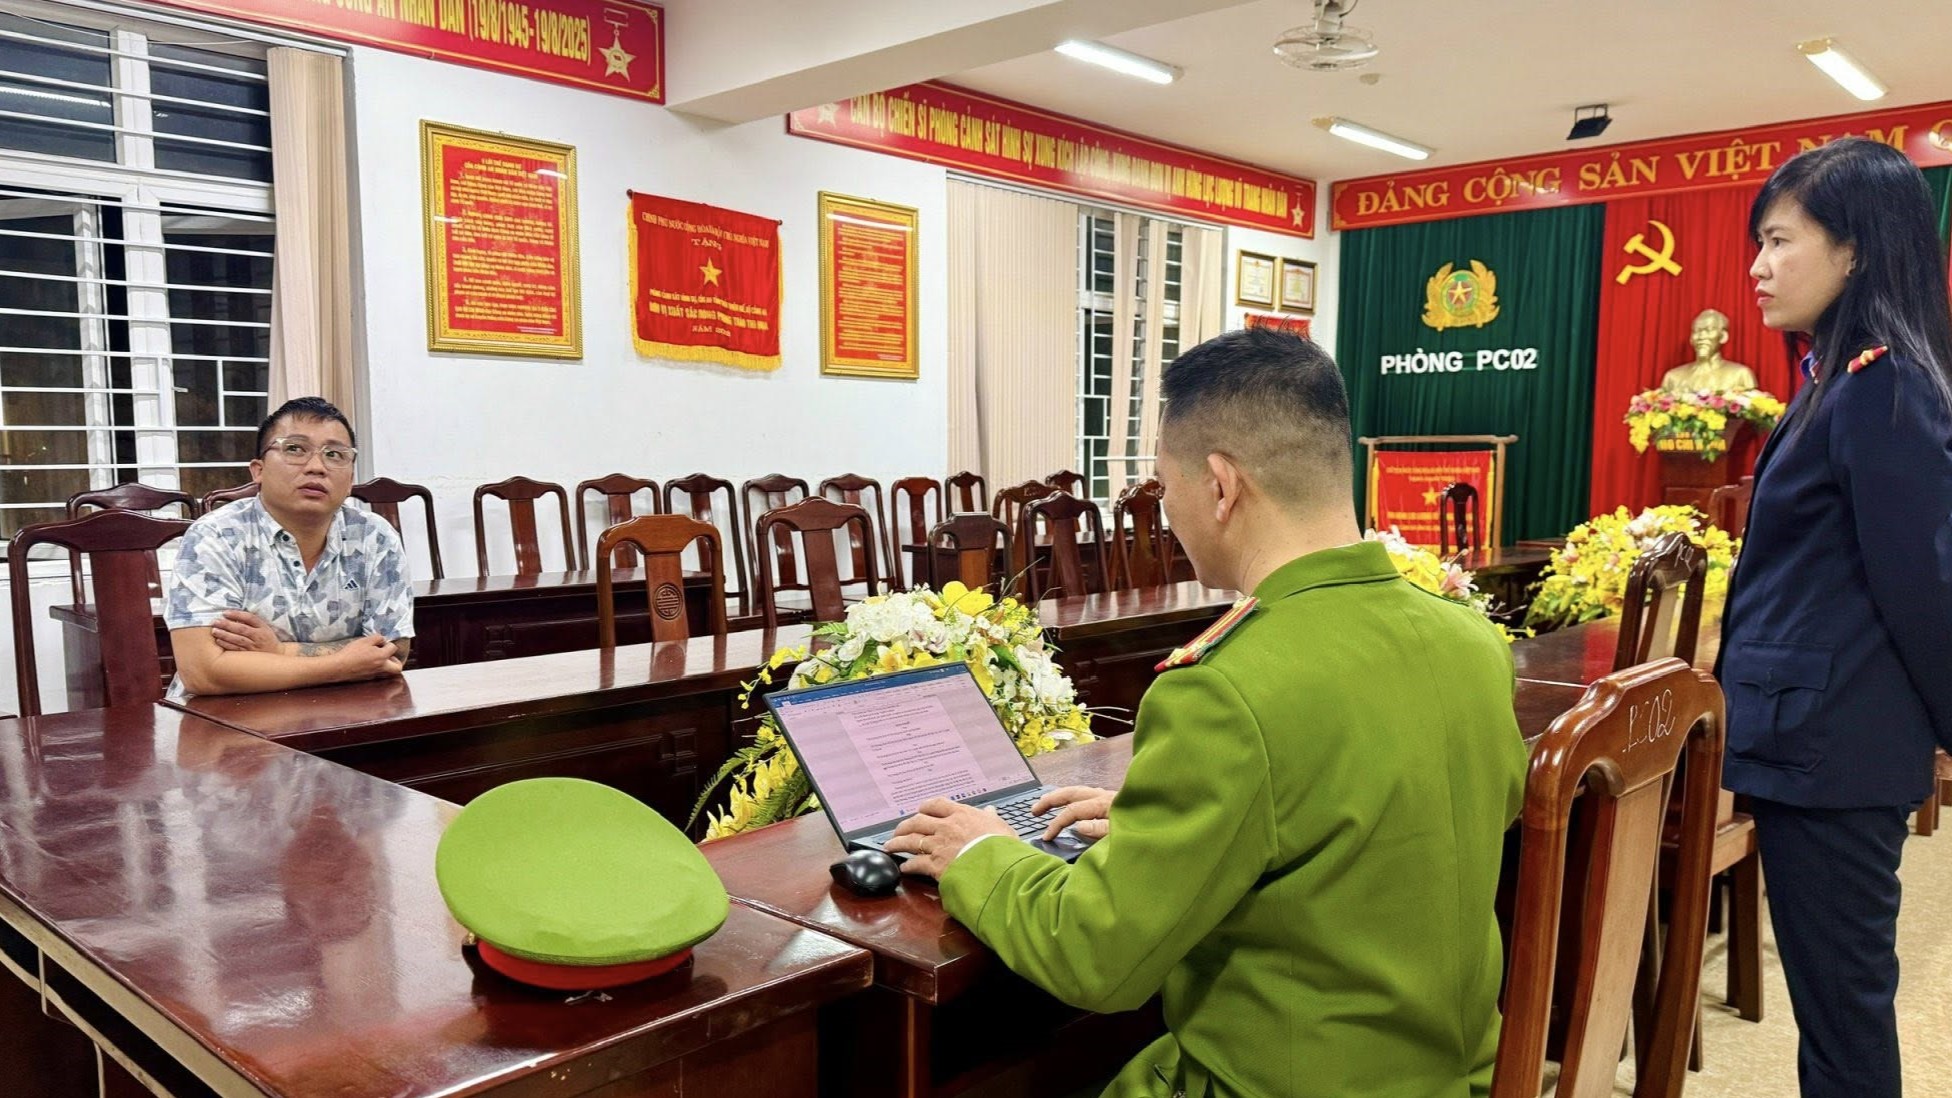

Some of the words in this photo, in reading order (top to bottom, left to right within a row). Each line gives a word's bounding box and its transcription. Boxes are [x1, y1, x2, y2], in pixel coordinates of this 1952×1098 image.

[1356, 179, 1450, 216] ĐẢNG
[1463, 167, 1562, 206] CỘNG
[1578, 151, 1661, 191] SẢN
[1675, 138, 1781, 181] VIỆT
[1380, 347, 1463, 375] PHÒNG
[1476, 348, 1538, 371] PC02
